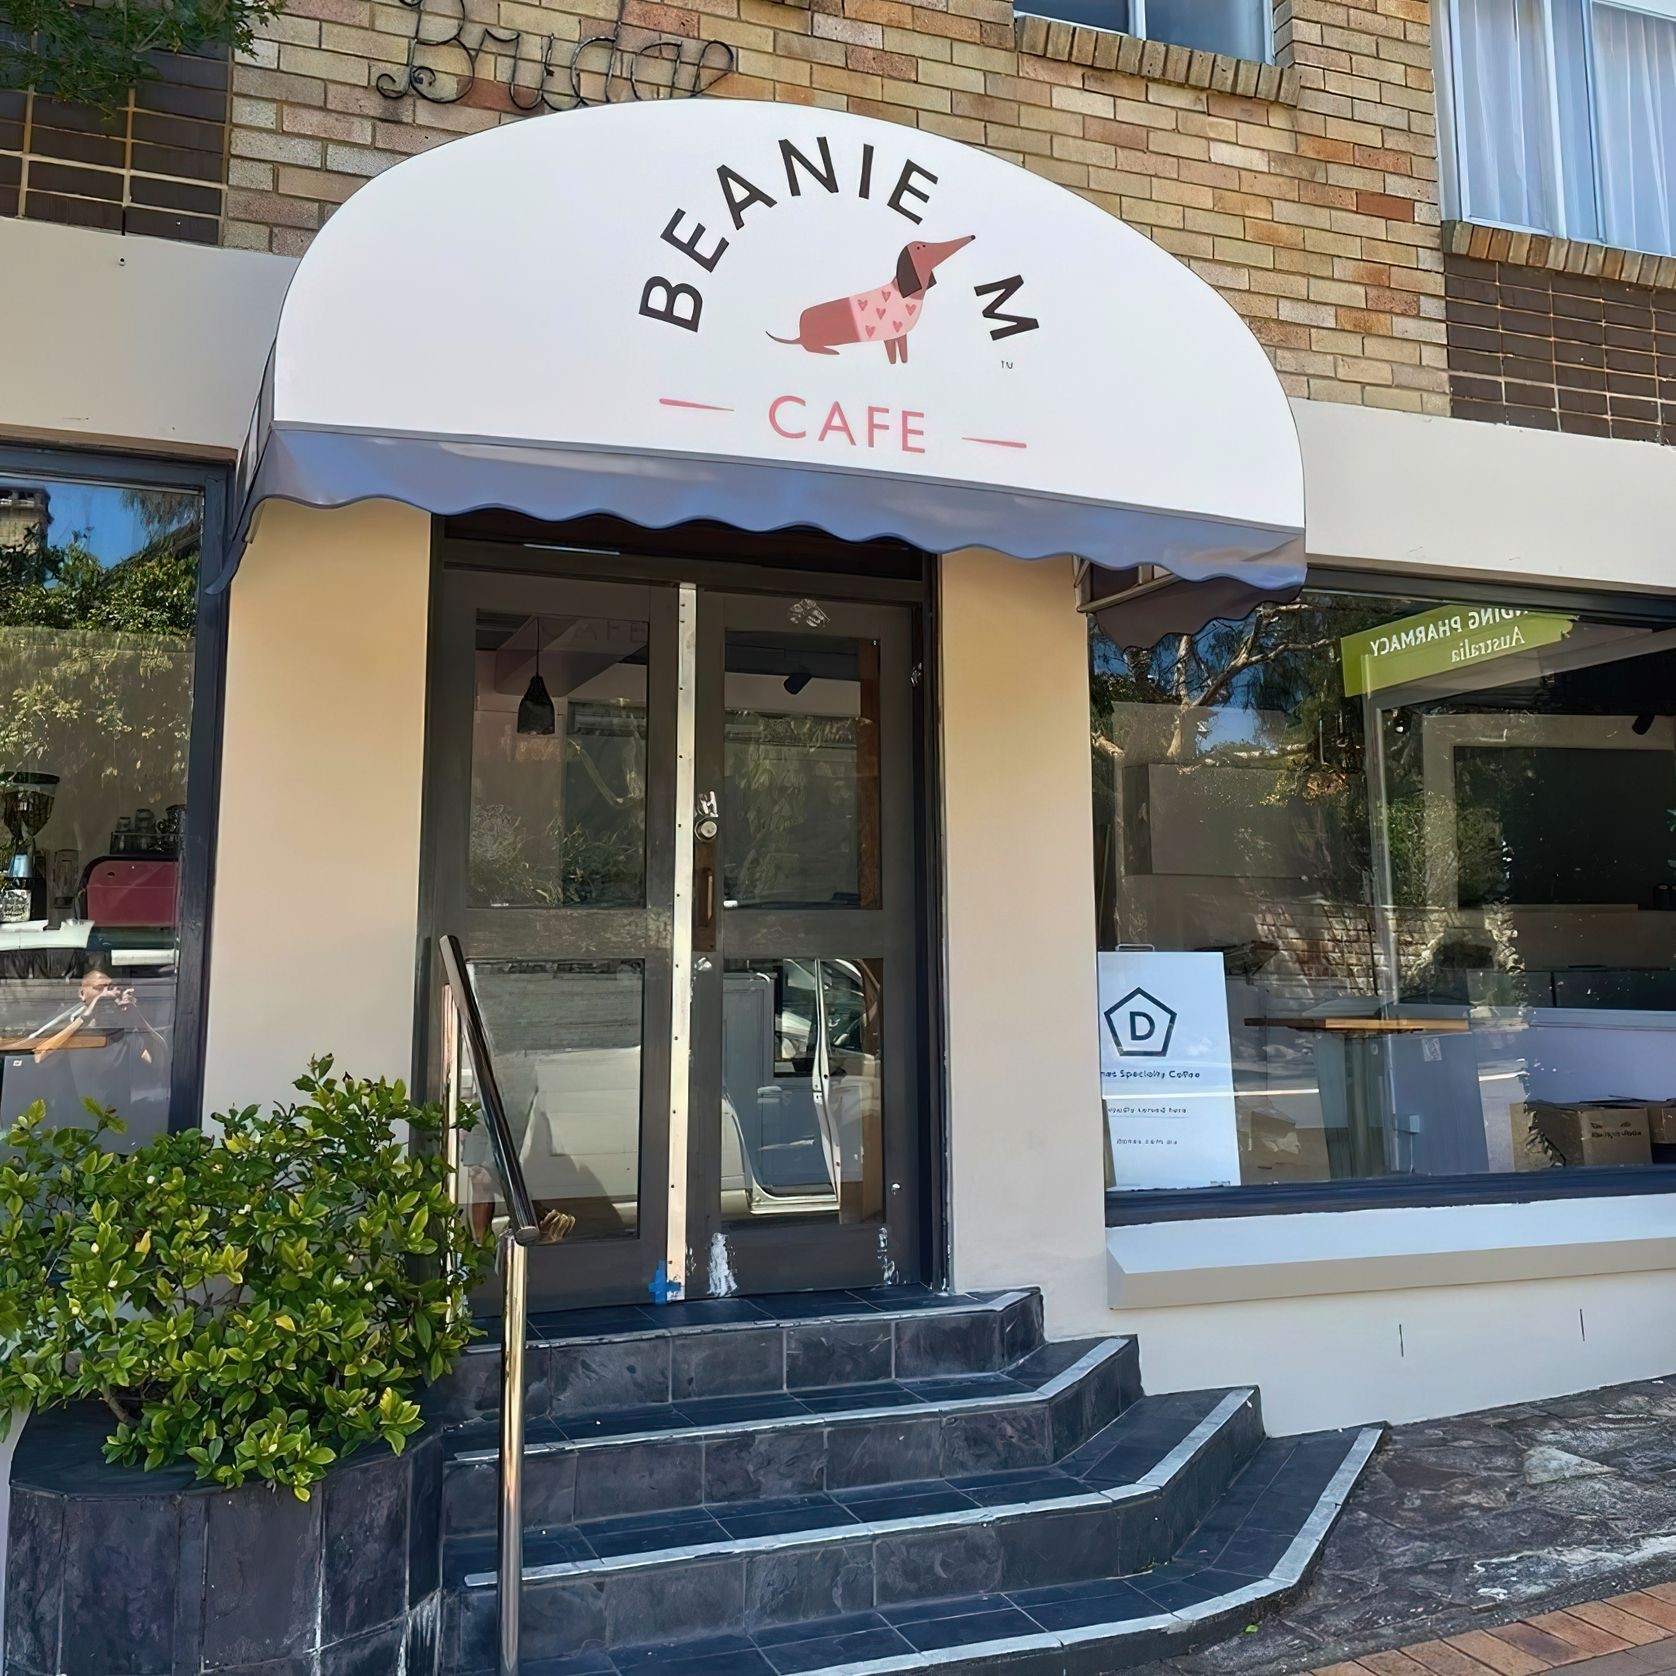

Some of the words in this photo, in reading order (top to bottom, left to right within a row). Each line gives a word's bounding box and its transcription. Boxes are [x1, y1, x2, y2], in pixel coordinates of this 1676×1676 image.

[638, 136, 939, 333] BEANIE
[973, 274, 1040, 341] M
[768, 395, 926, 454] CAFE
[1129, 1011, 1156, 1041] D
